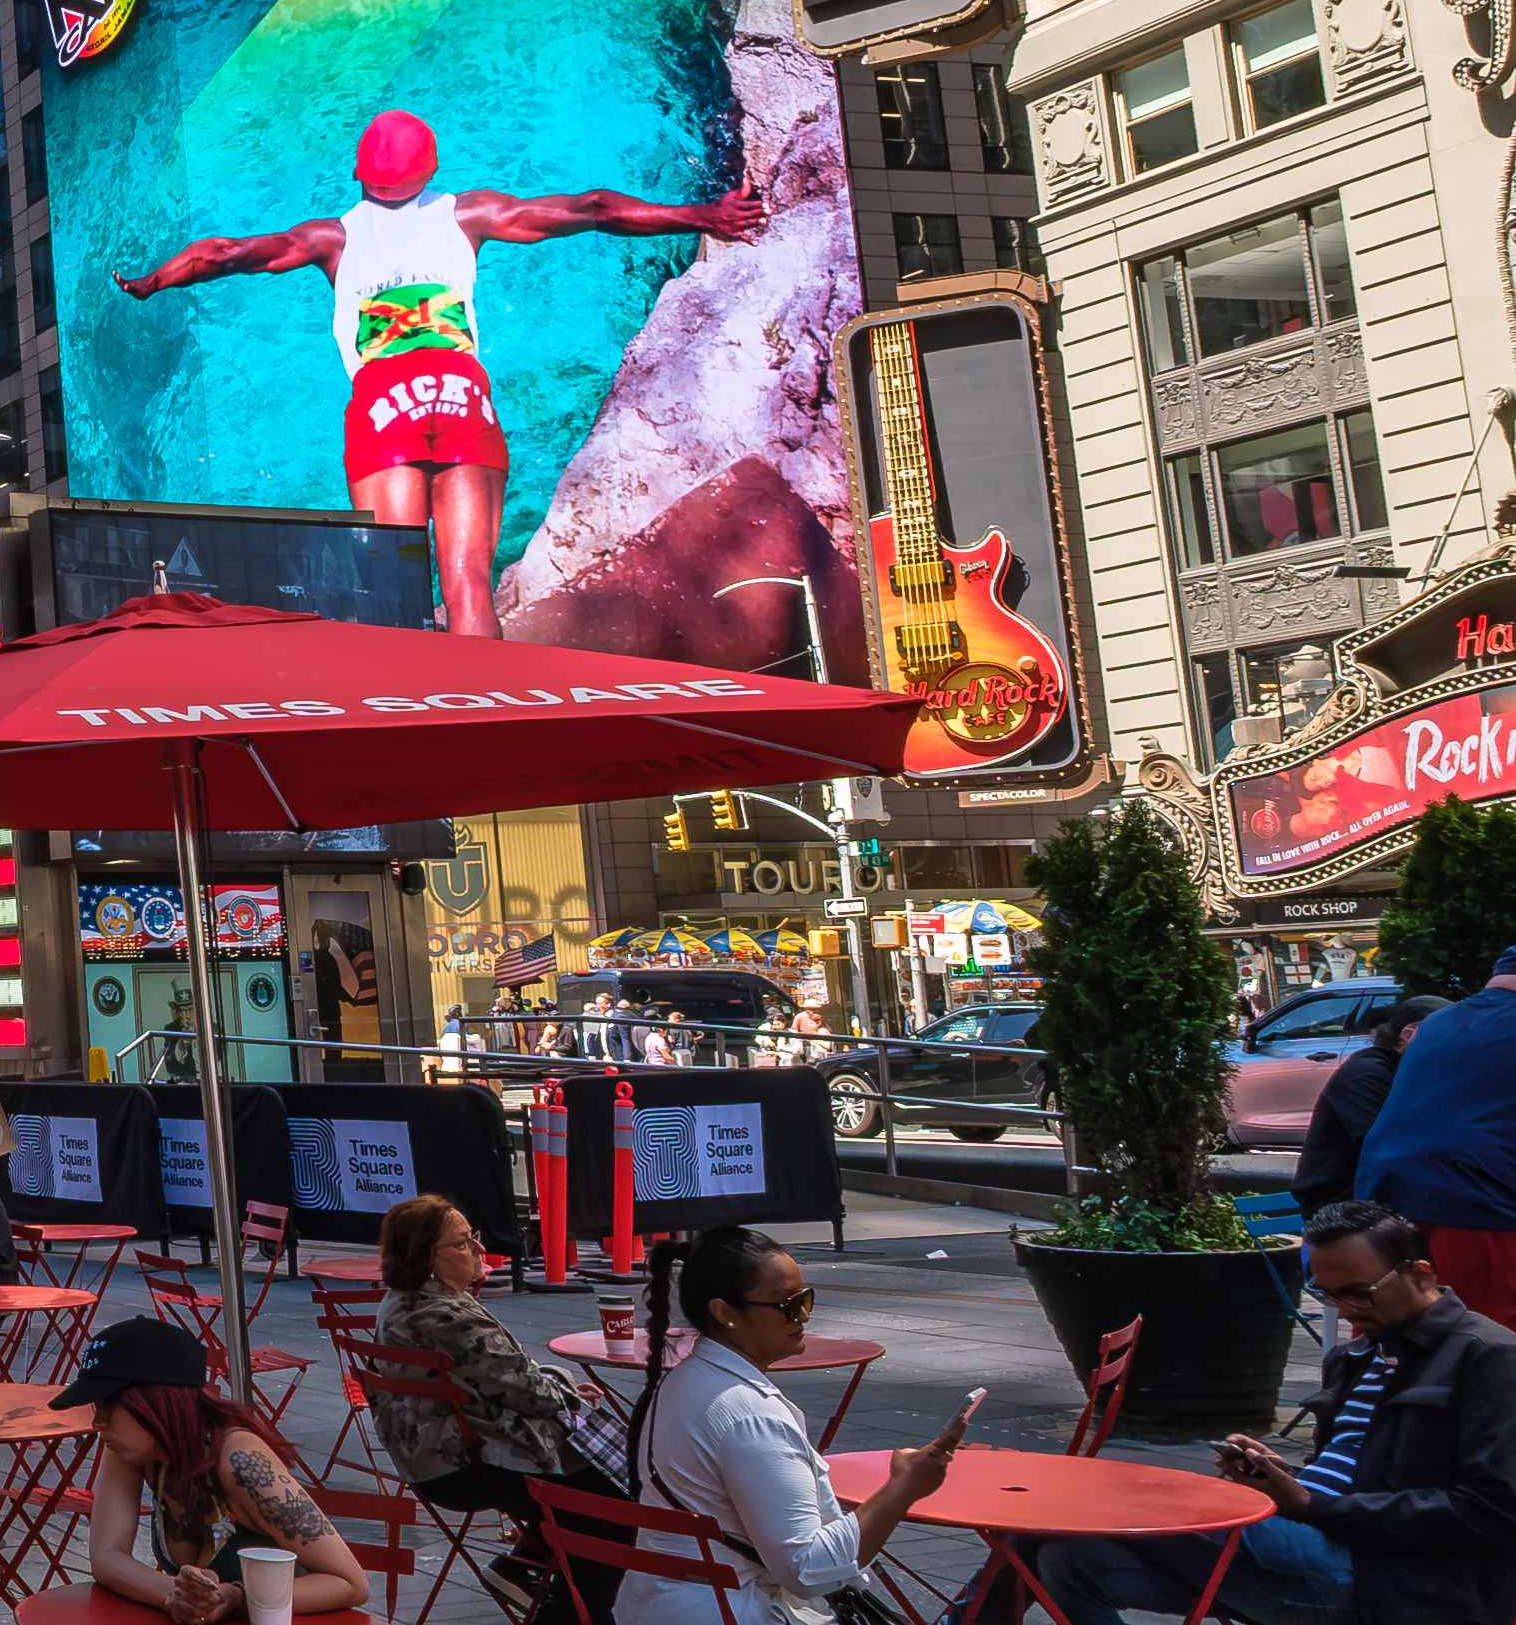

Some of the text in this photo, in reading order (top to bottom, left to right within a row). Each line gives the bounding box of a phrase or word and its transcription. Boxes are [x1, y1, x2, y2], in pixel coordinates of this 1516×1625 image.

[903, 674, 1060, 711] Hard Rock
[58, 677, 766, 727] TIMES SQUARE
[962, 712, 1006, 726] CAFE
[969, 787, 1047, 803] SPECTACOLOR
[1281, 847, 1301, 861] LOVE
[1349, 822, 1363, 835] ALL
[1284, 901, 1358, 917] ROCK SHOP
[708, 1124, 749, 1141] Times
[59, 1134, 89, 1151] Times
[161, 1136, 200, 1153] Times
[349, 1139, 398, 1158] Times
[706, 1142, 753, 1159] Square
[58, 1150, 92, 1168] Square
[160, 1153, 204, 1172] Square
[348, 1158, 403, 1177] Square
[61, 1168, 92, 1184] Alliance
[710, 1162, 753, 1177] Alliance
[355, 1177, 403, 1195] Alliance
